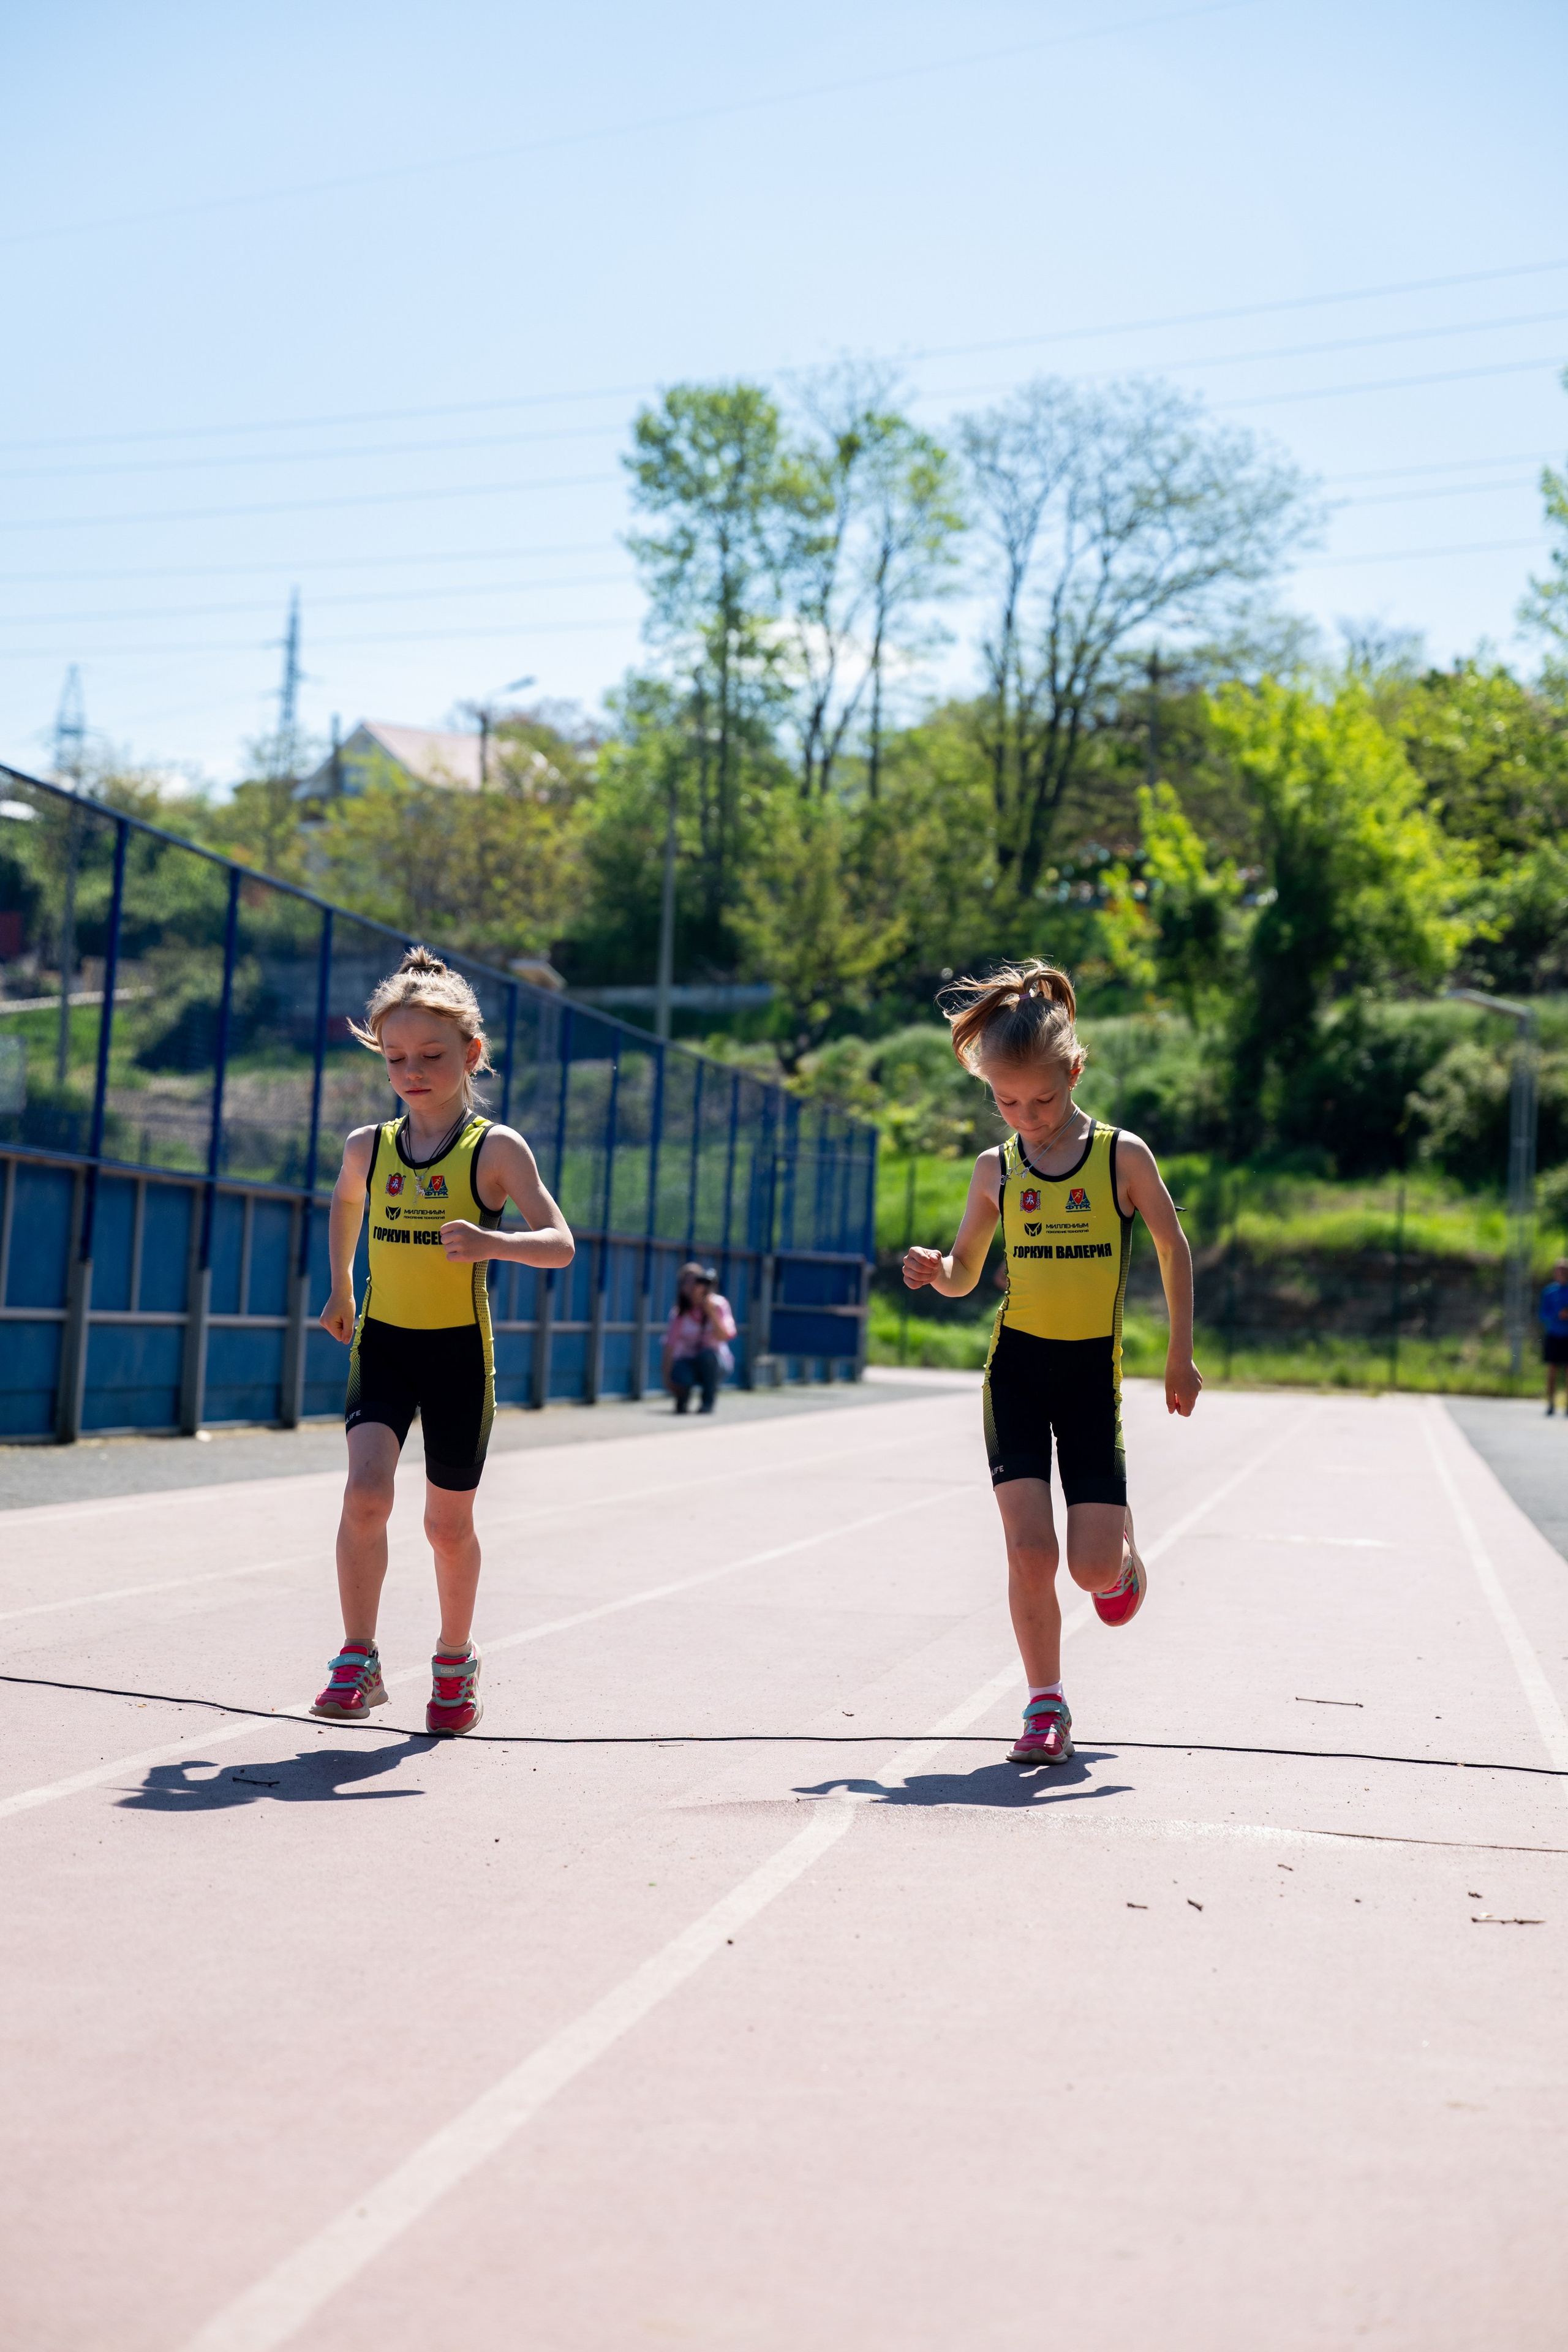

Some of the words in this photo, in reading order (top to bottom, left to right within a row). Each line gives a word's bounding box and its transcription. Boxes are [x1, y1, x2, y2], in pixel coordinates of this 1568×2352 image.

[373, 1226, 410, 1244] ГОРКУН
[1013, 1245, 1053, 1259] ГОРКУН
[1056, 1243, 1112, 1259] ВАЛЕРИЯ
